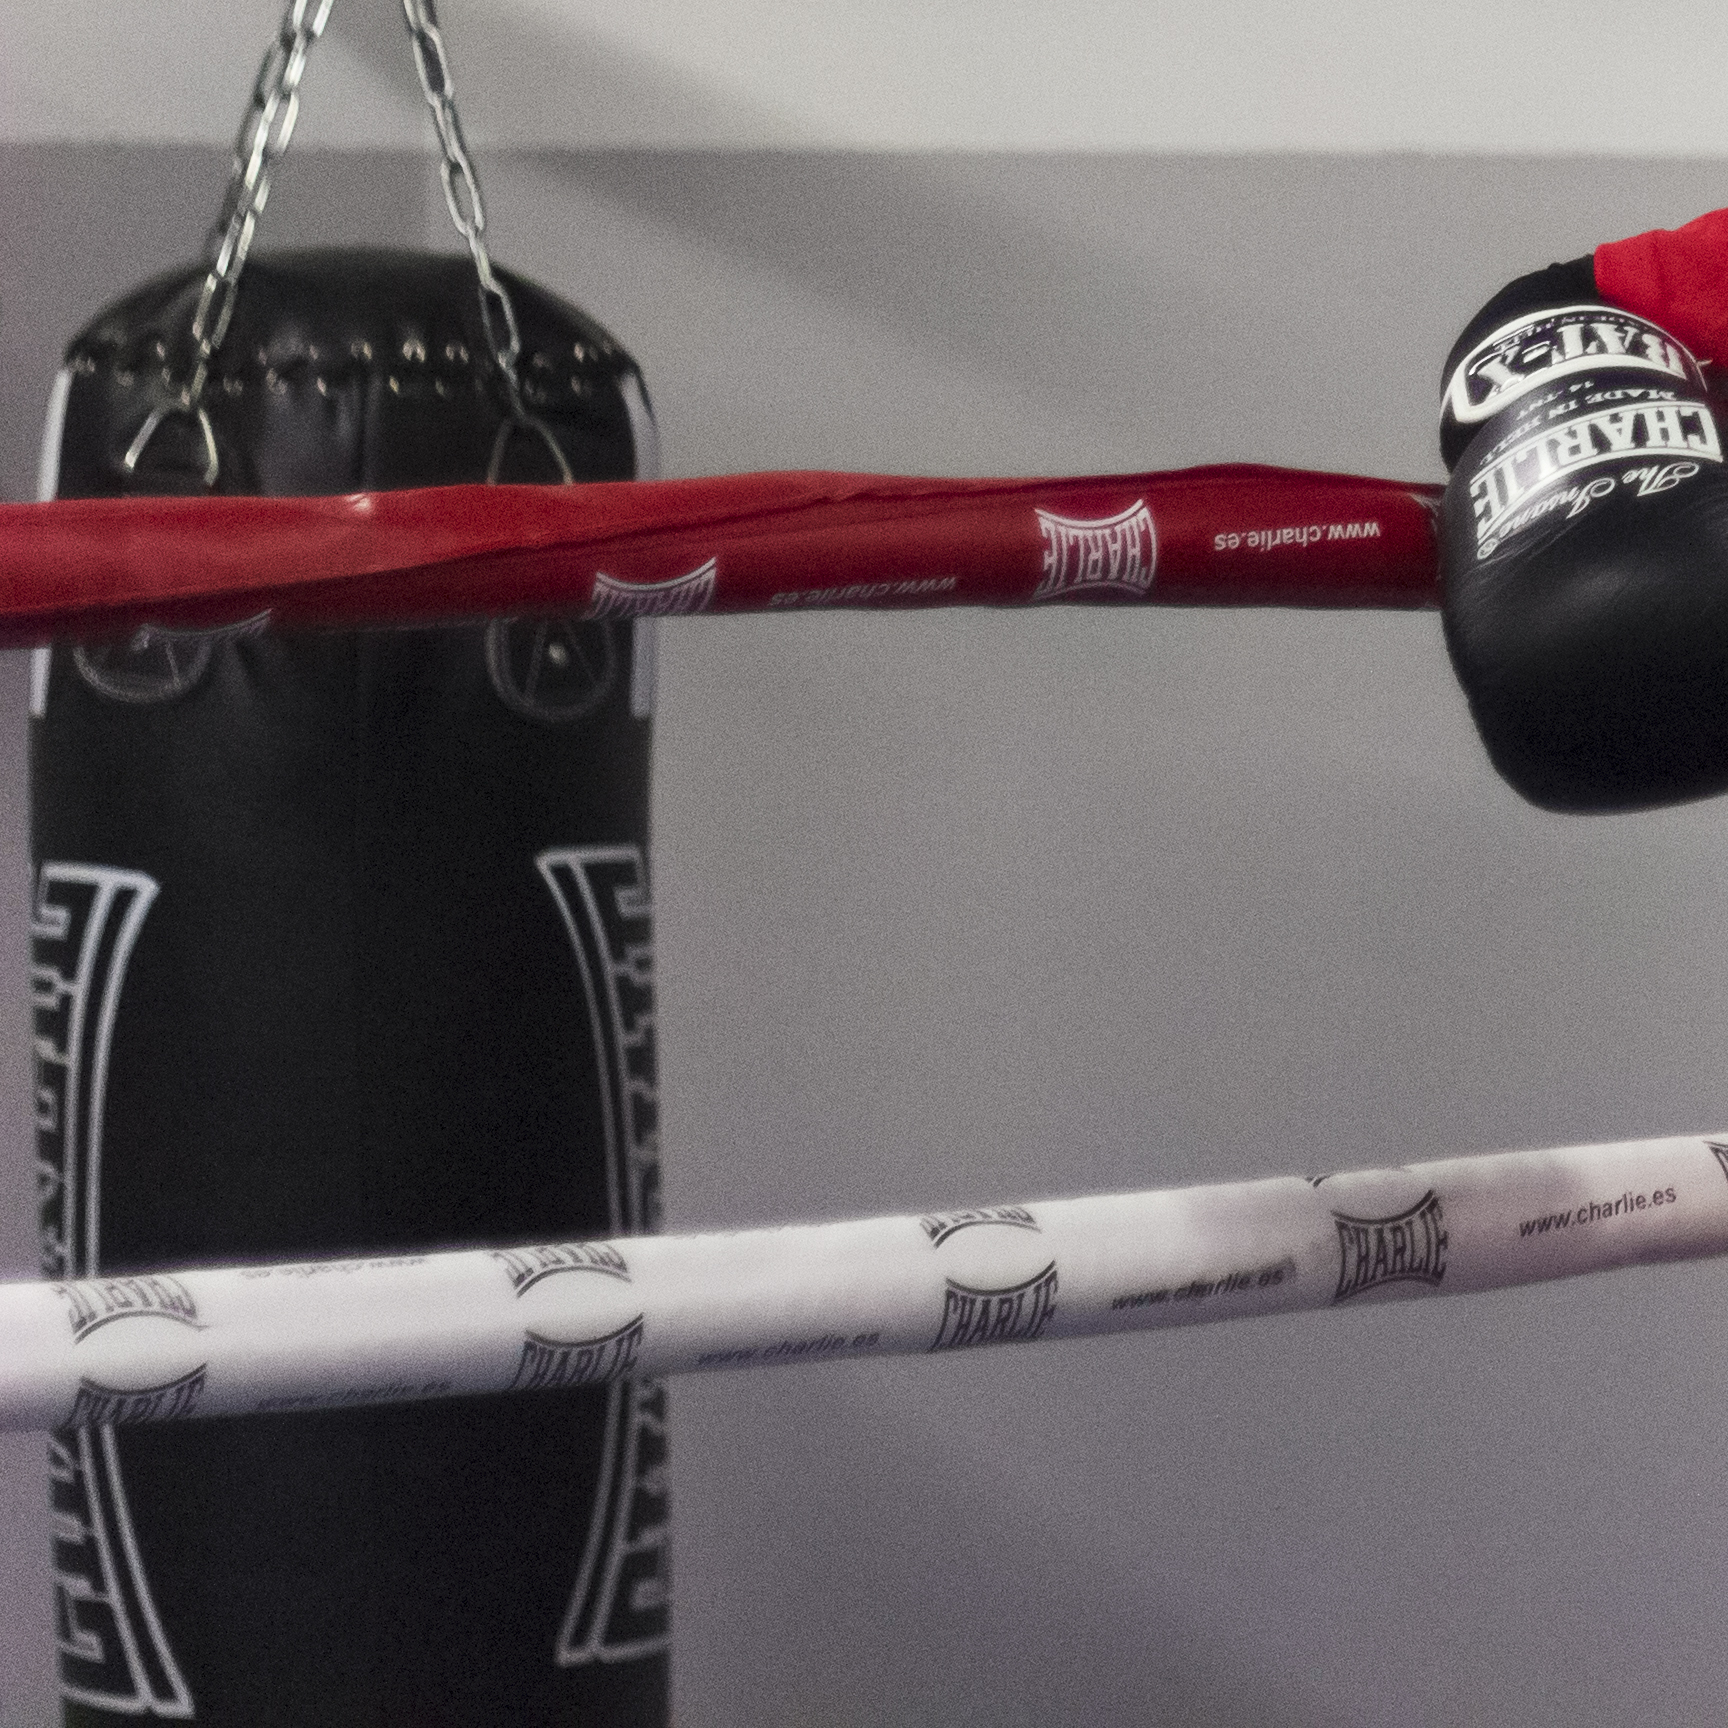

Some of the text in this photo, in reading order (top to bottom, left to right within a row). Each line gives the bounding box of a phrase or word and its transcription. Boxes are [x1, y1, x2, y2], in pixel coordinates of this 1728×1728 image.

[1550, 399, 1579, 419] IN
[1585, 389, 1677, 405] MADE
[1470, 404, 1723, 542] CHARLIE
[1622, 461, 1700, 498] The
[1034, 506, 1158, 599] CHARLIE
[1214, 521, 1381, 553] www.charlie.es
[1518, 1186, 1678, 1239] www.charlie.es
[1332, 1197, 1449, 1304] CHARLIE
